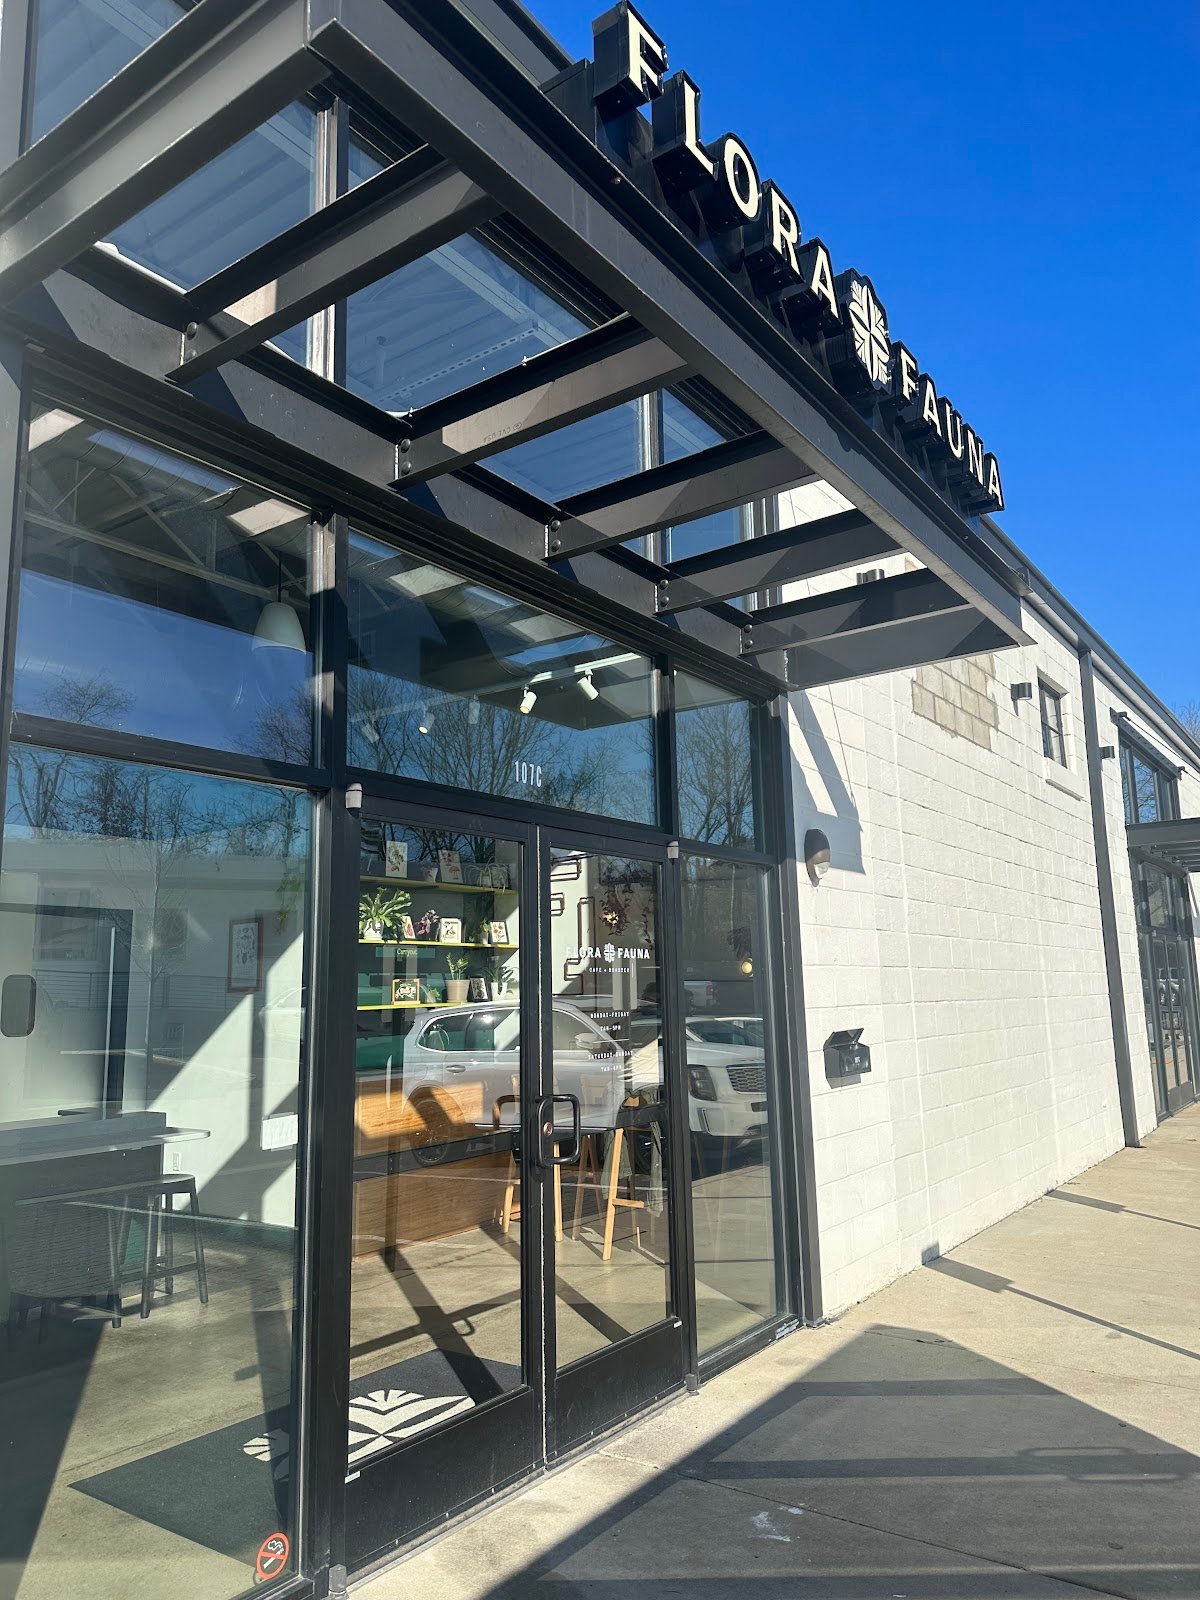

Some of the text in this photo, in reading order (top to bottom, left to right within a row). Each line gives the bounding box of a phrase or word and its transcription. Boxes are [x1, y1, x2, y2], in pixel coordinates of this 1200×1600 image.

[626, 9, 1004, 508] FLORA FAUNA
[515, 760, 542, 787] 107C
[618, 947, 650, 959] FAUNA
